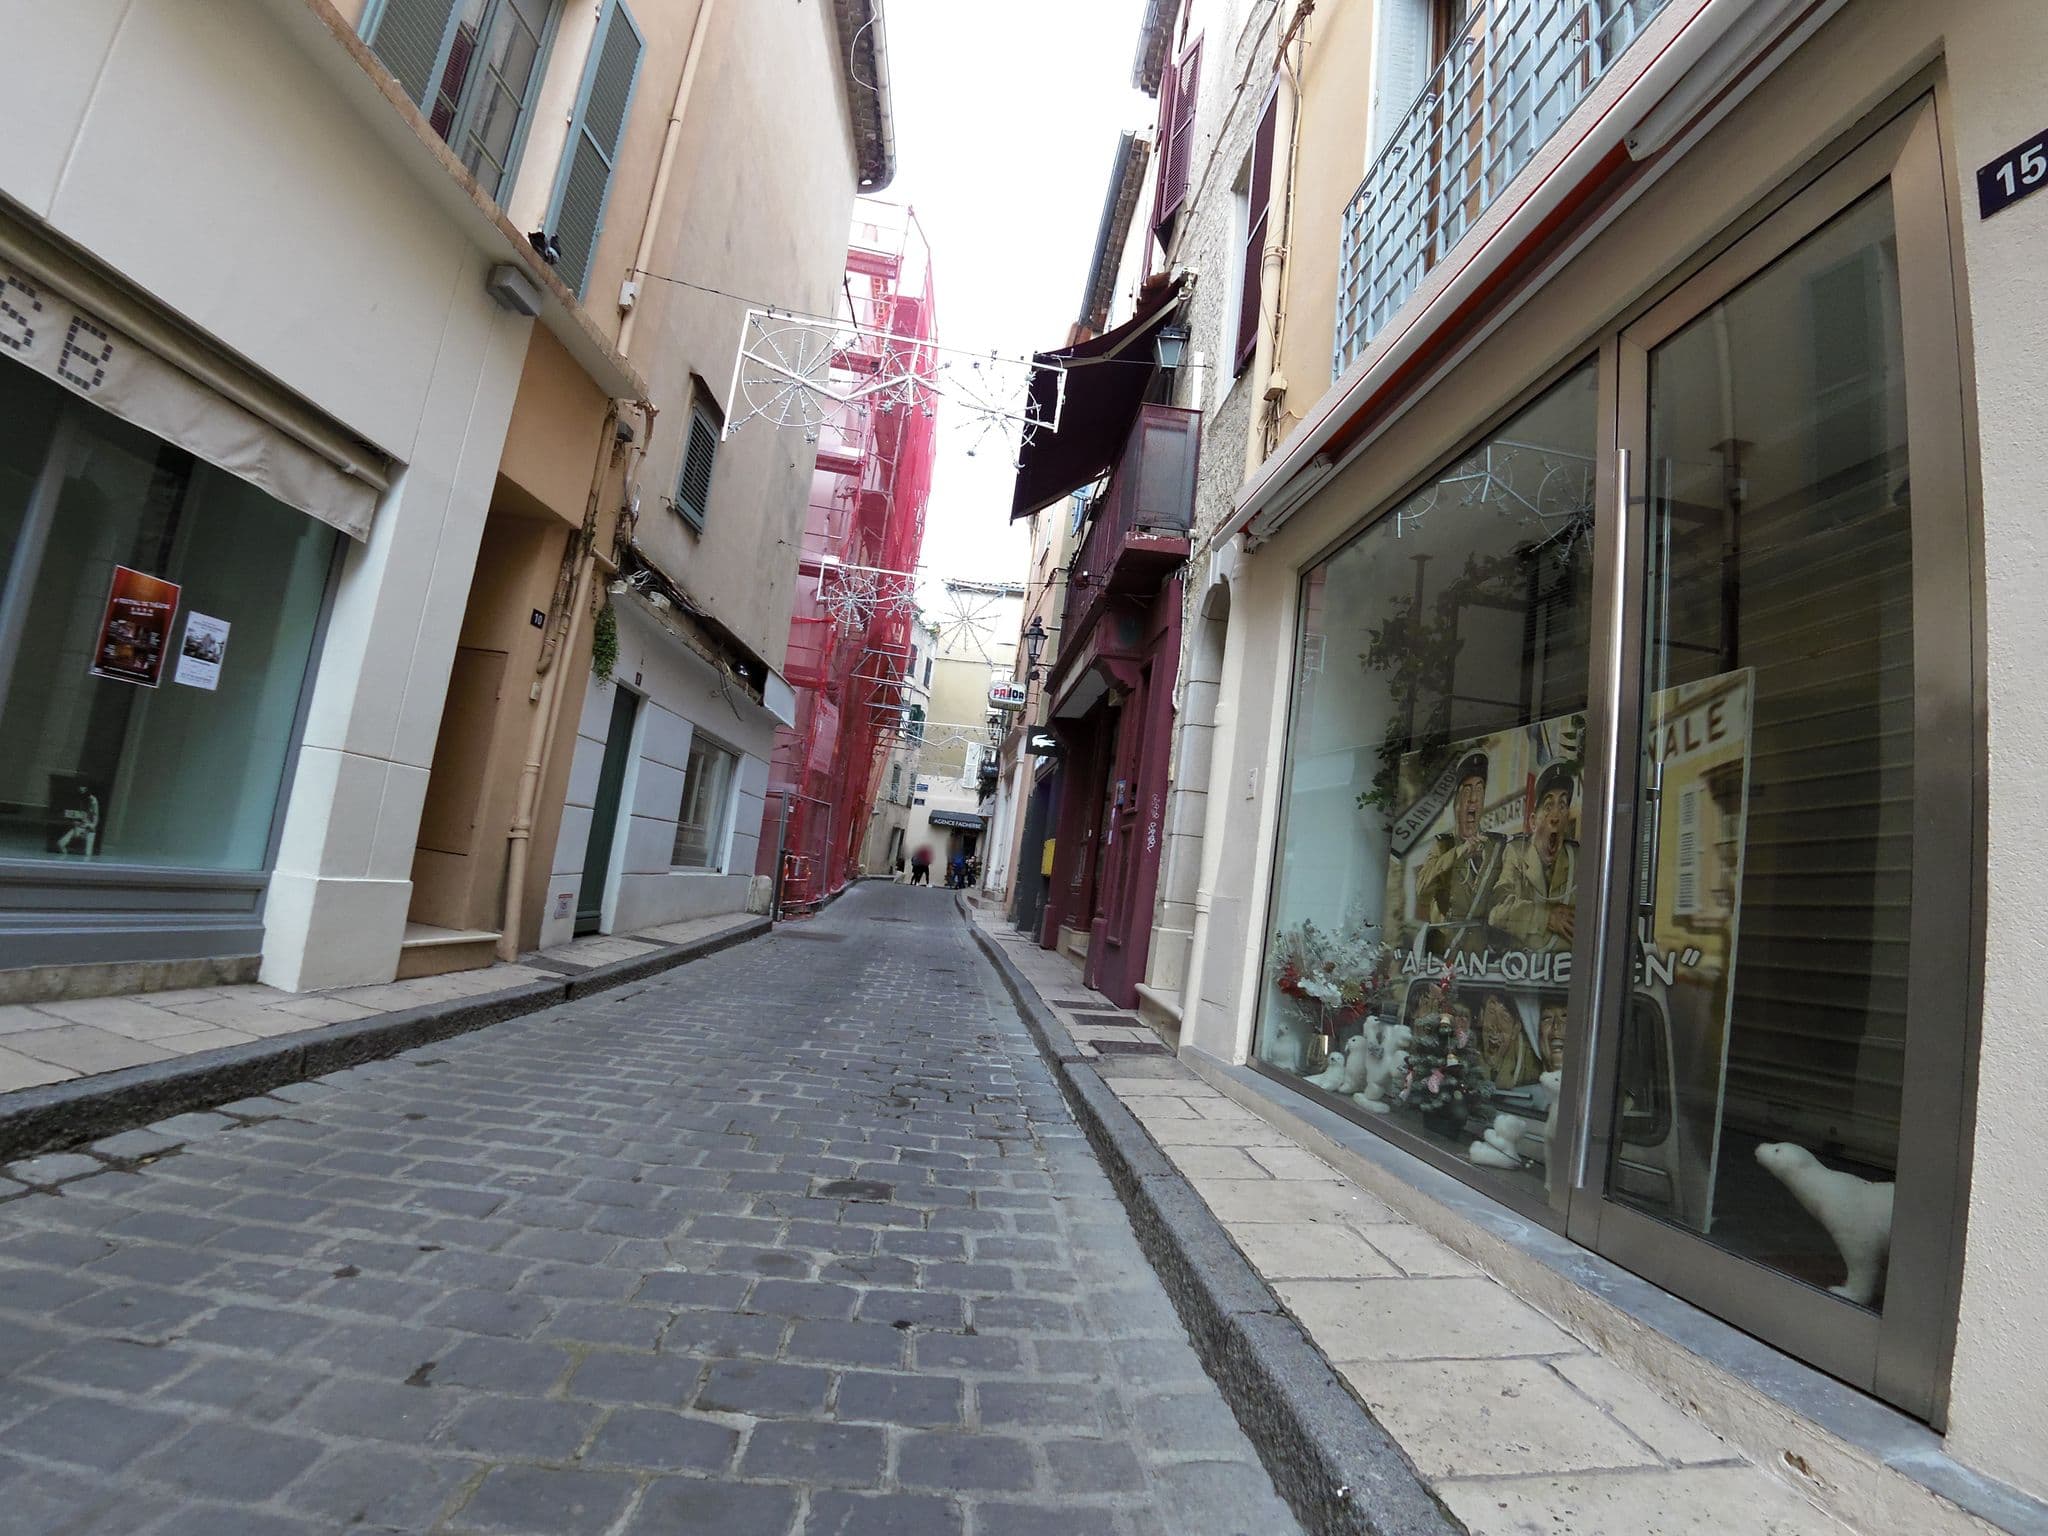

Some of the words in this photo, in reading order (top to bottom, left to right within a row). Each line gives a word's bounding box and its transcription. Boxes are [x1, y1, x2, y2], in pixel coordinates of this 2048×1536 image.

[1996, 143, 2047, 197] 15
[534, 613, 544, 625] 10
[1500, 950, 1572, 982] QUE
